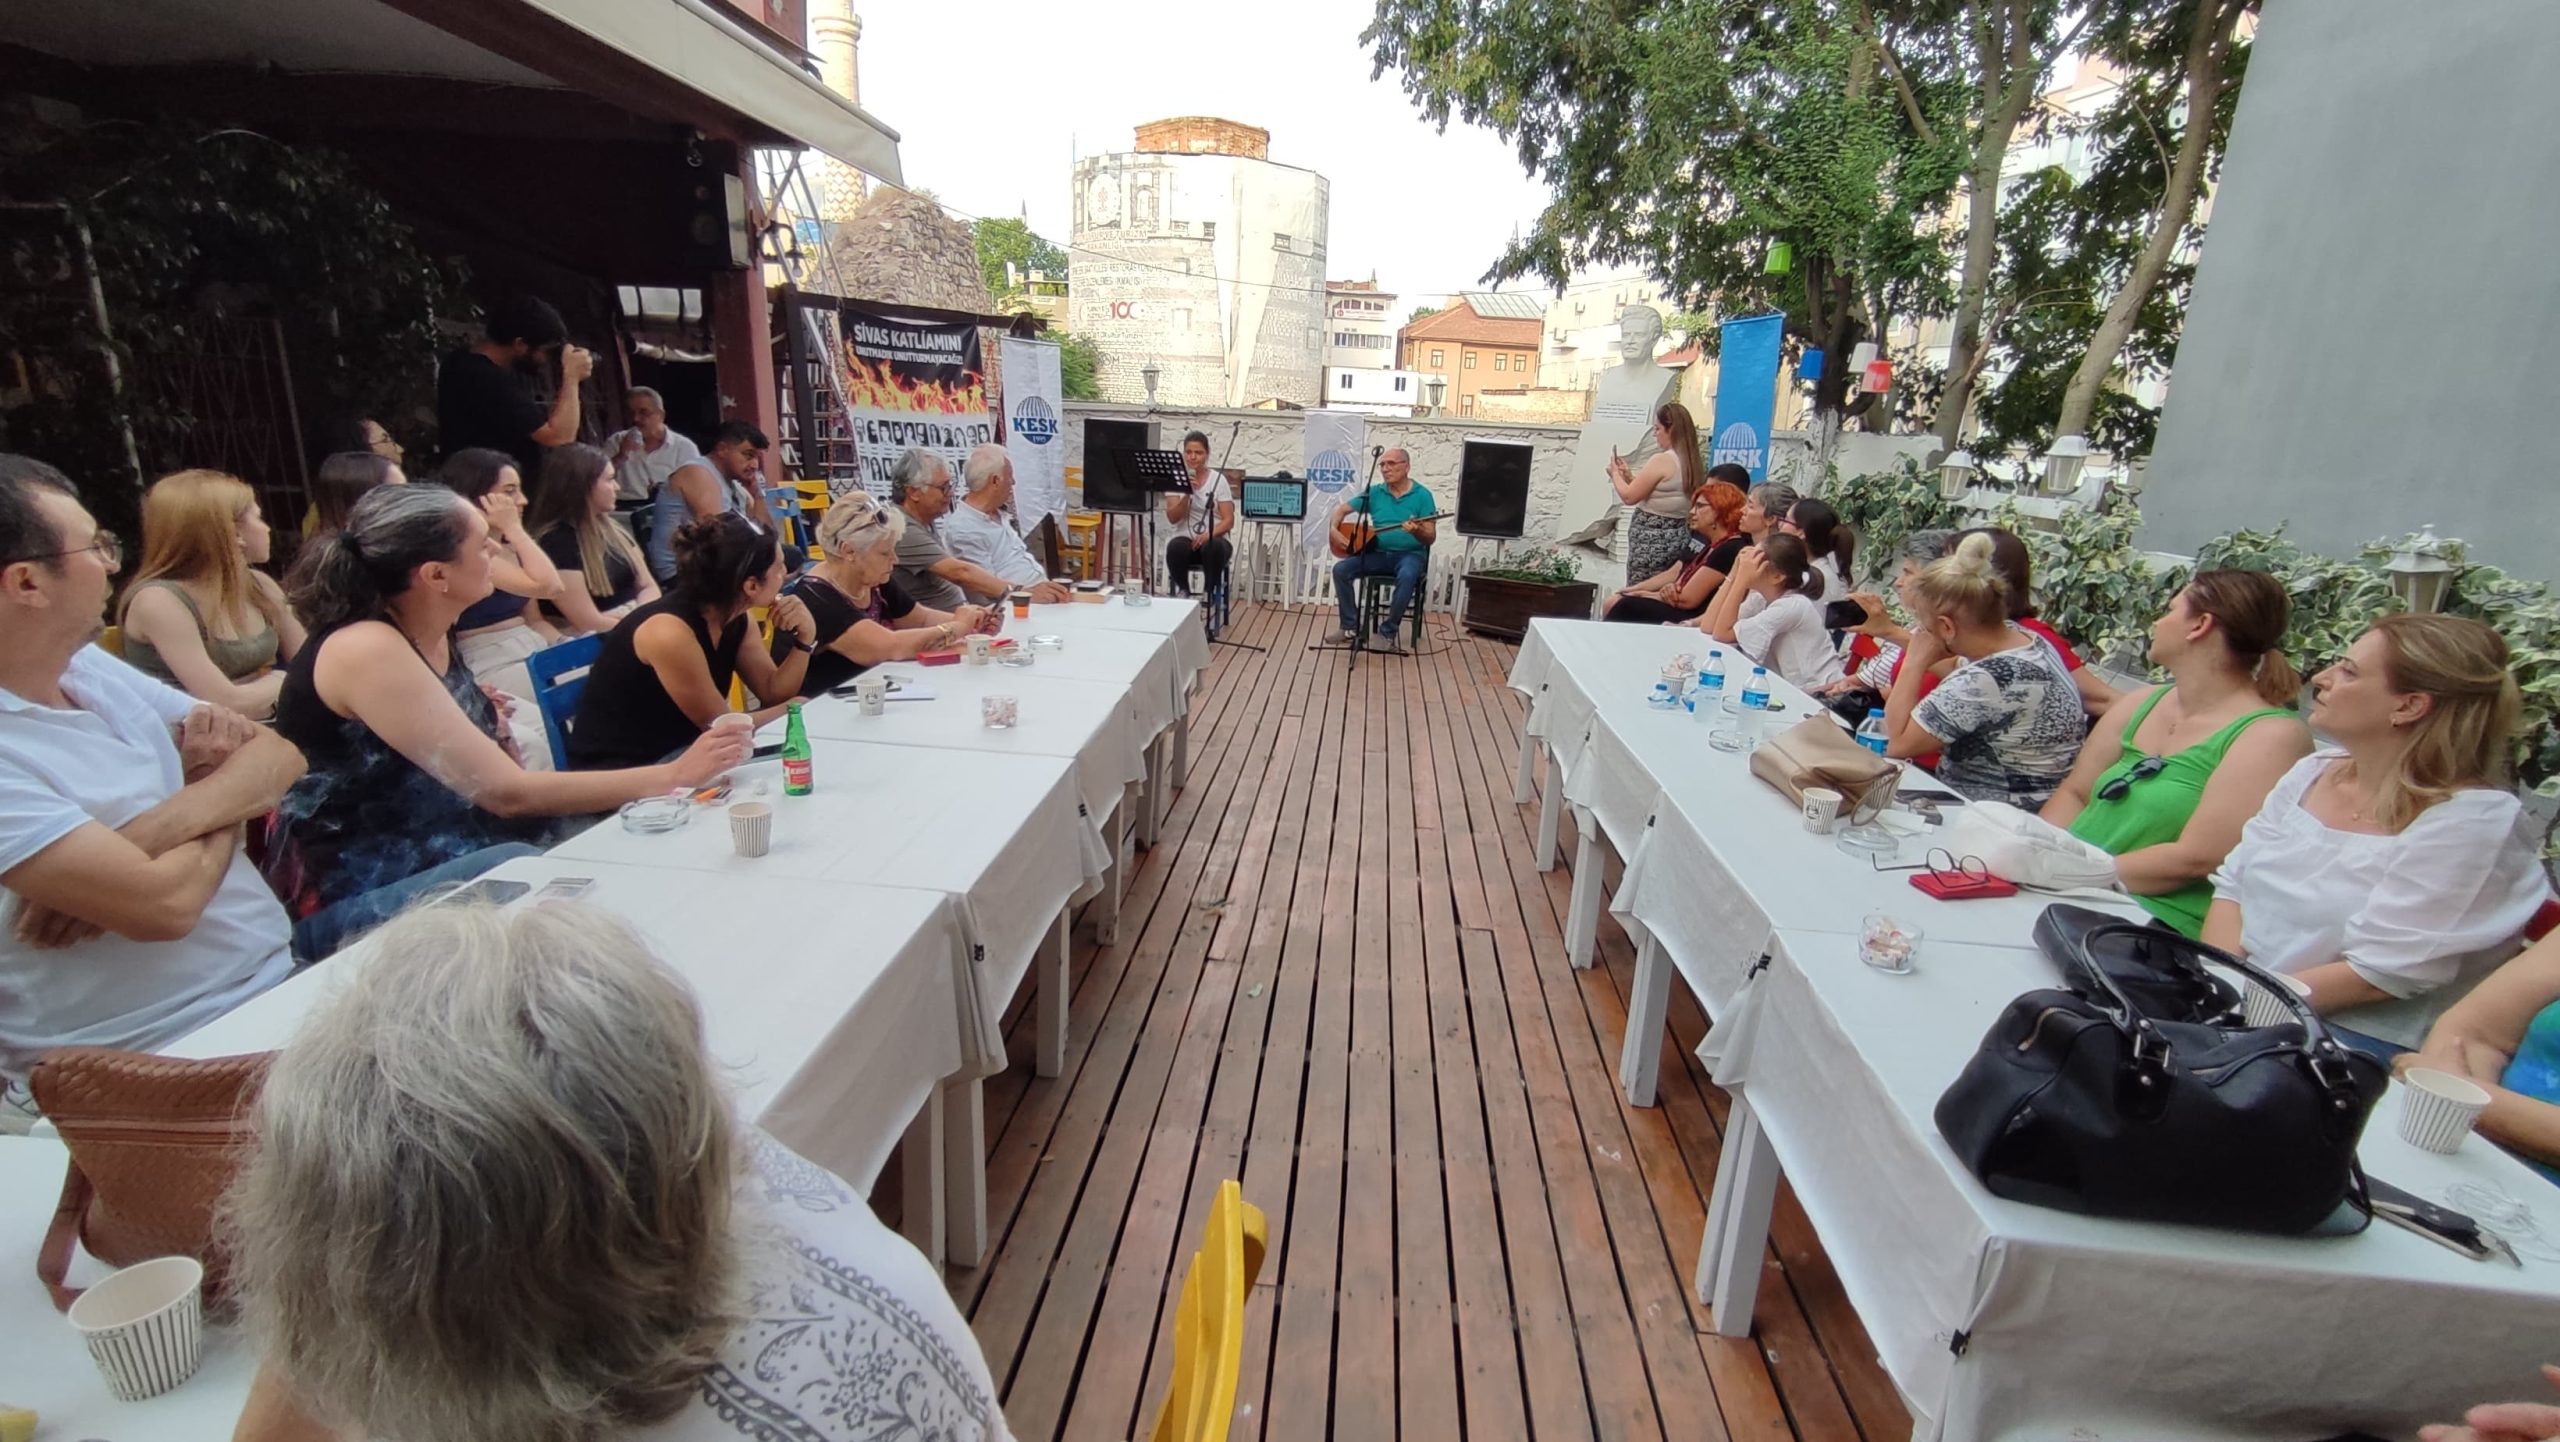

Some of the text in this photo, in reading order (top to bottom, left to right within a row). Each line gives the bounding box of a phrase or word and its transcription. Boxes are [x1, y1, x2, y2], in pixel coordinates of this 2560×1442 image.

[854, 322, 962, 352] SİVAS KATLİAMINI
[1012, 417, 1059, 434] KESK
[1712, 448, 1763, 469] KESK
[1306, 468, 1356, 483] KESK
